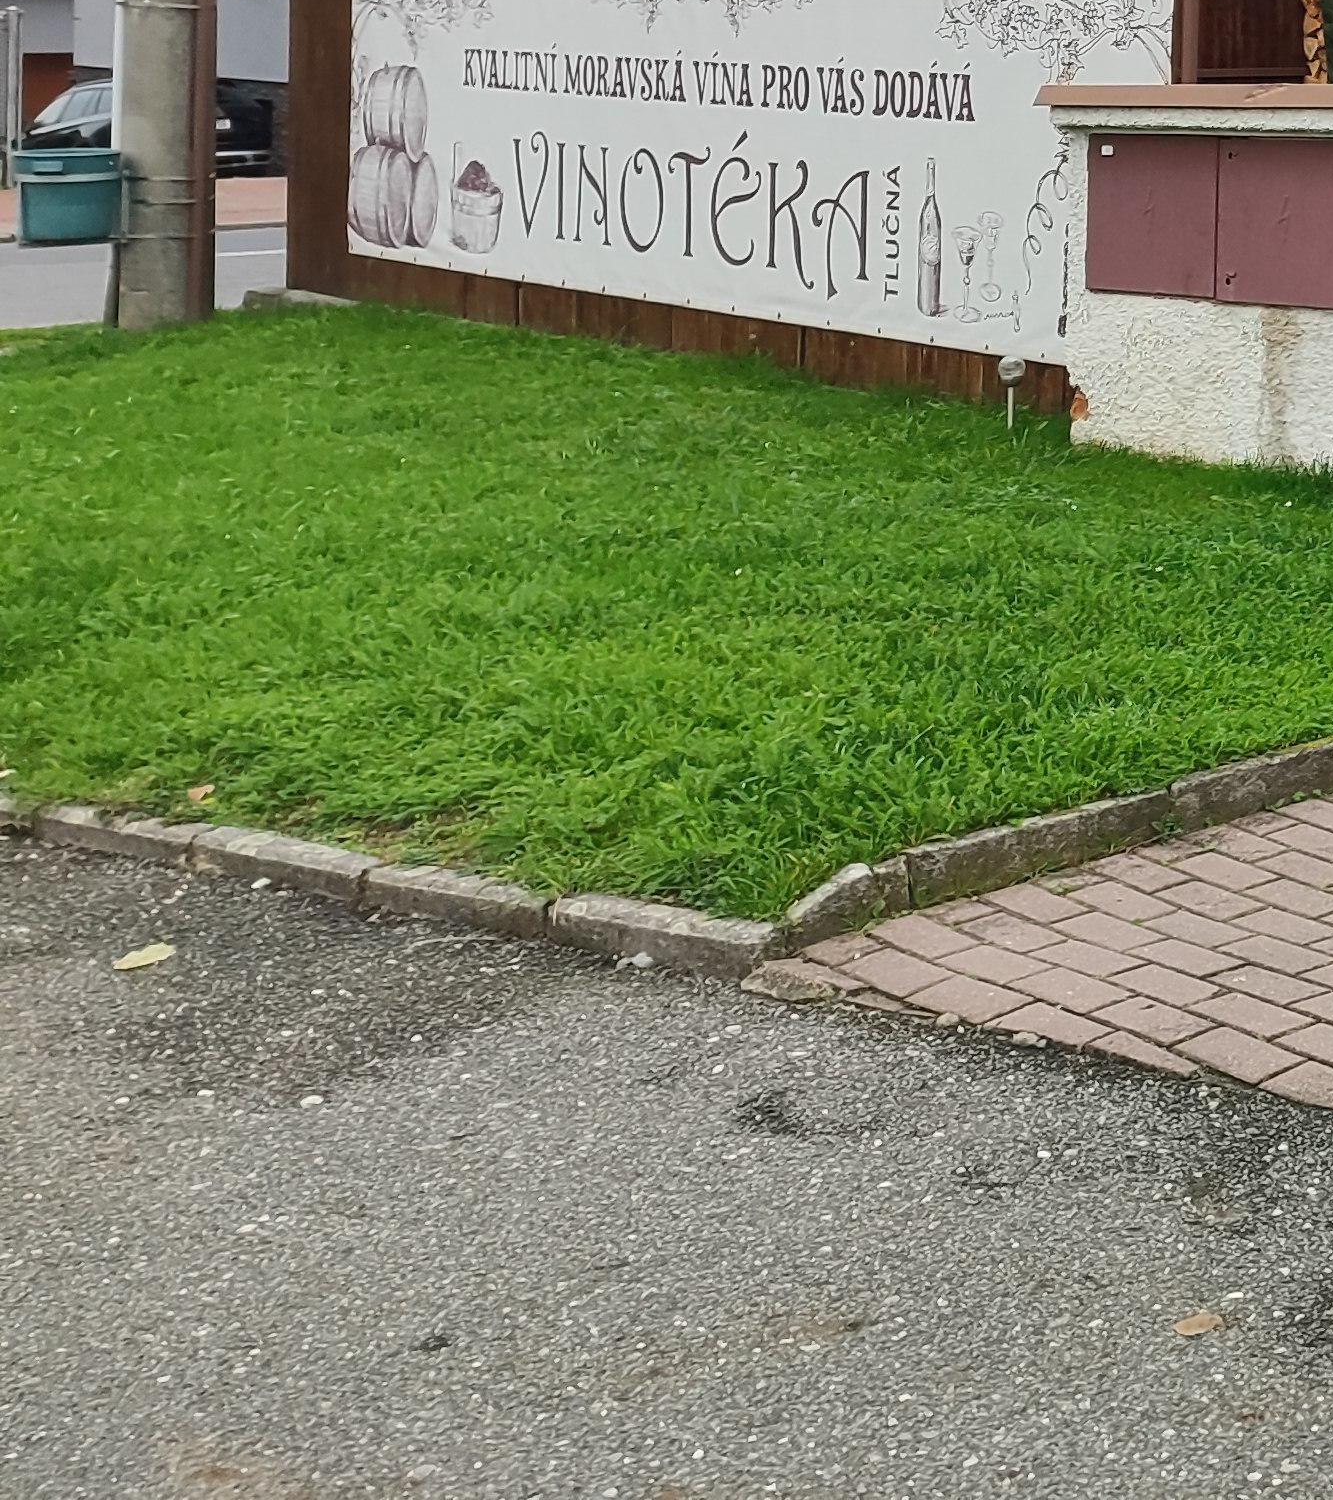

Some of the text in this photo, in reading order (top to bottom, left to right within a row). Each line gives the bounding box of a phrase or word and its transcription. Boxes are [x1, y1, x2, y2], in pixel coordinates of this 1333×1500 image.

[463, 43, 976, 122] KVALITNÍ MORAVSKÁ VÍNA PRO VÁS DODÁVÁ
[512, 131, 870, 300] VINOTÉKA
[881, 165, 901, 301] TLUČNÁ
